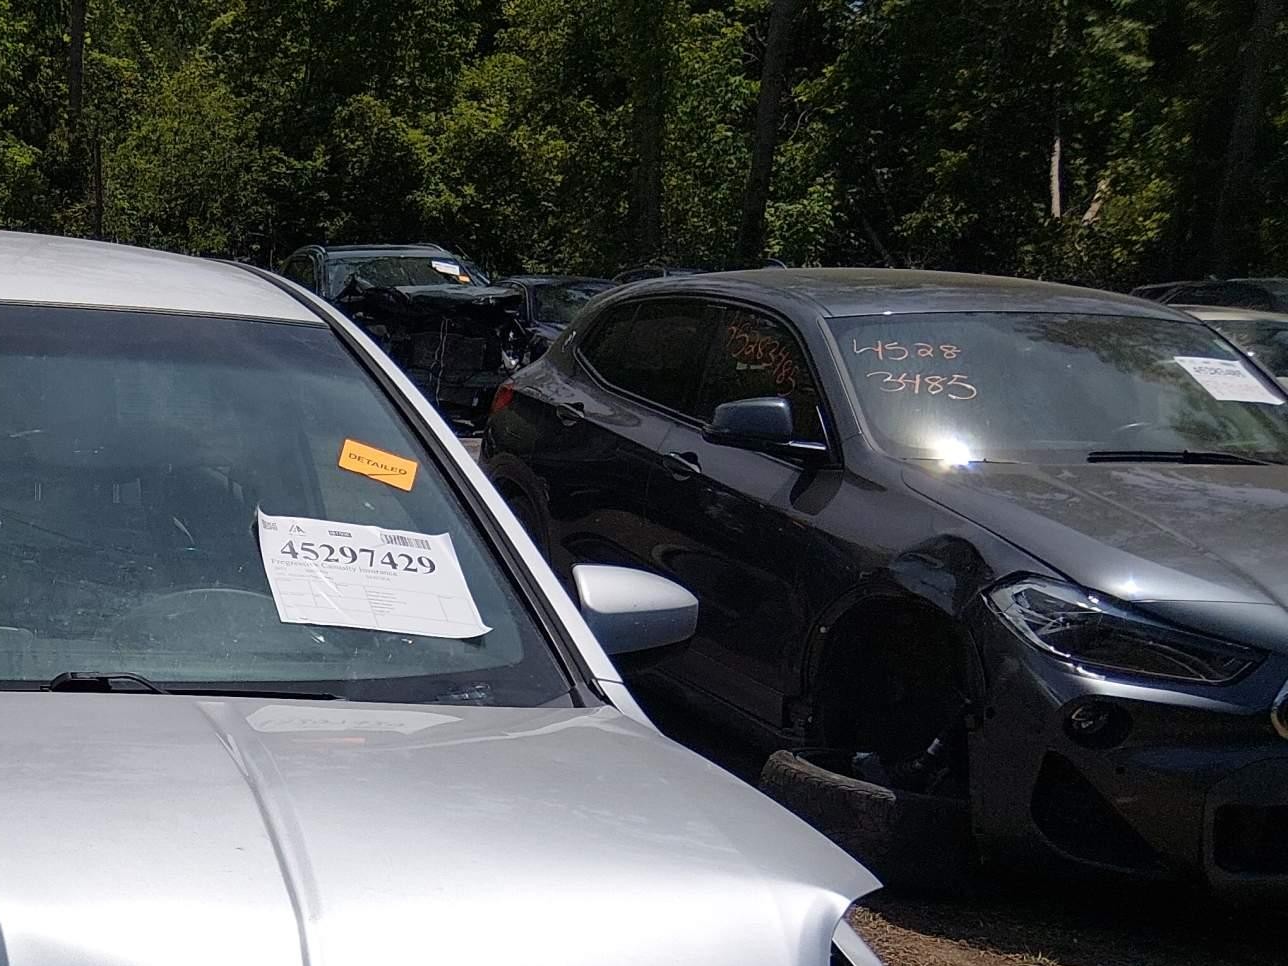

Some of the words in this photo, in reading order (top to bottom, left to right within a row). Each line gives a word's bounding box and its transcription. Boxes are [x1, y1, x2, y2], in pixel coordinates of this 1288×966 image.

[852, 338, 961, 361] 4528
[866, 371, 977, 400] 3485
[348, 453, 408, 476] DETAILED
[280, 540, 436, 575] 45297429
